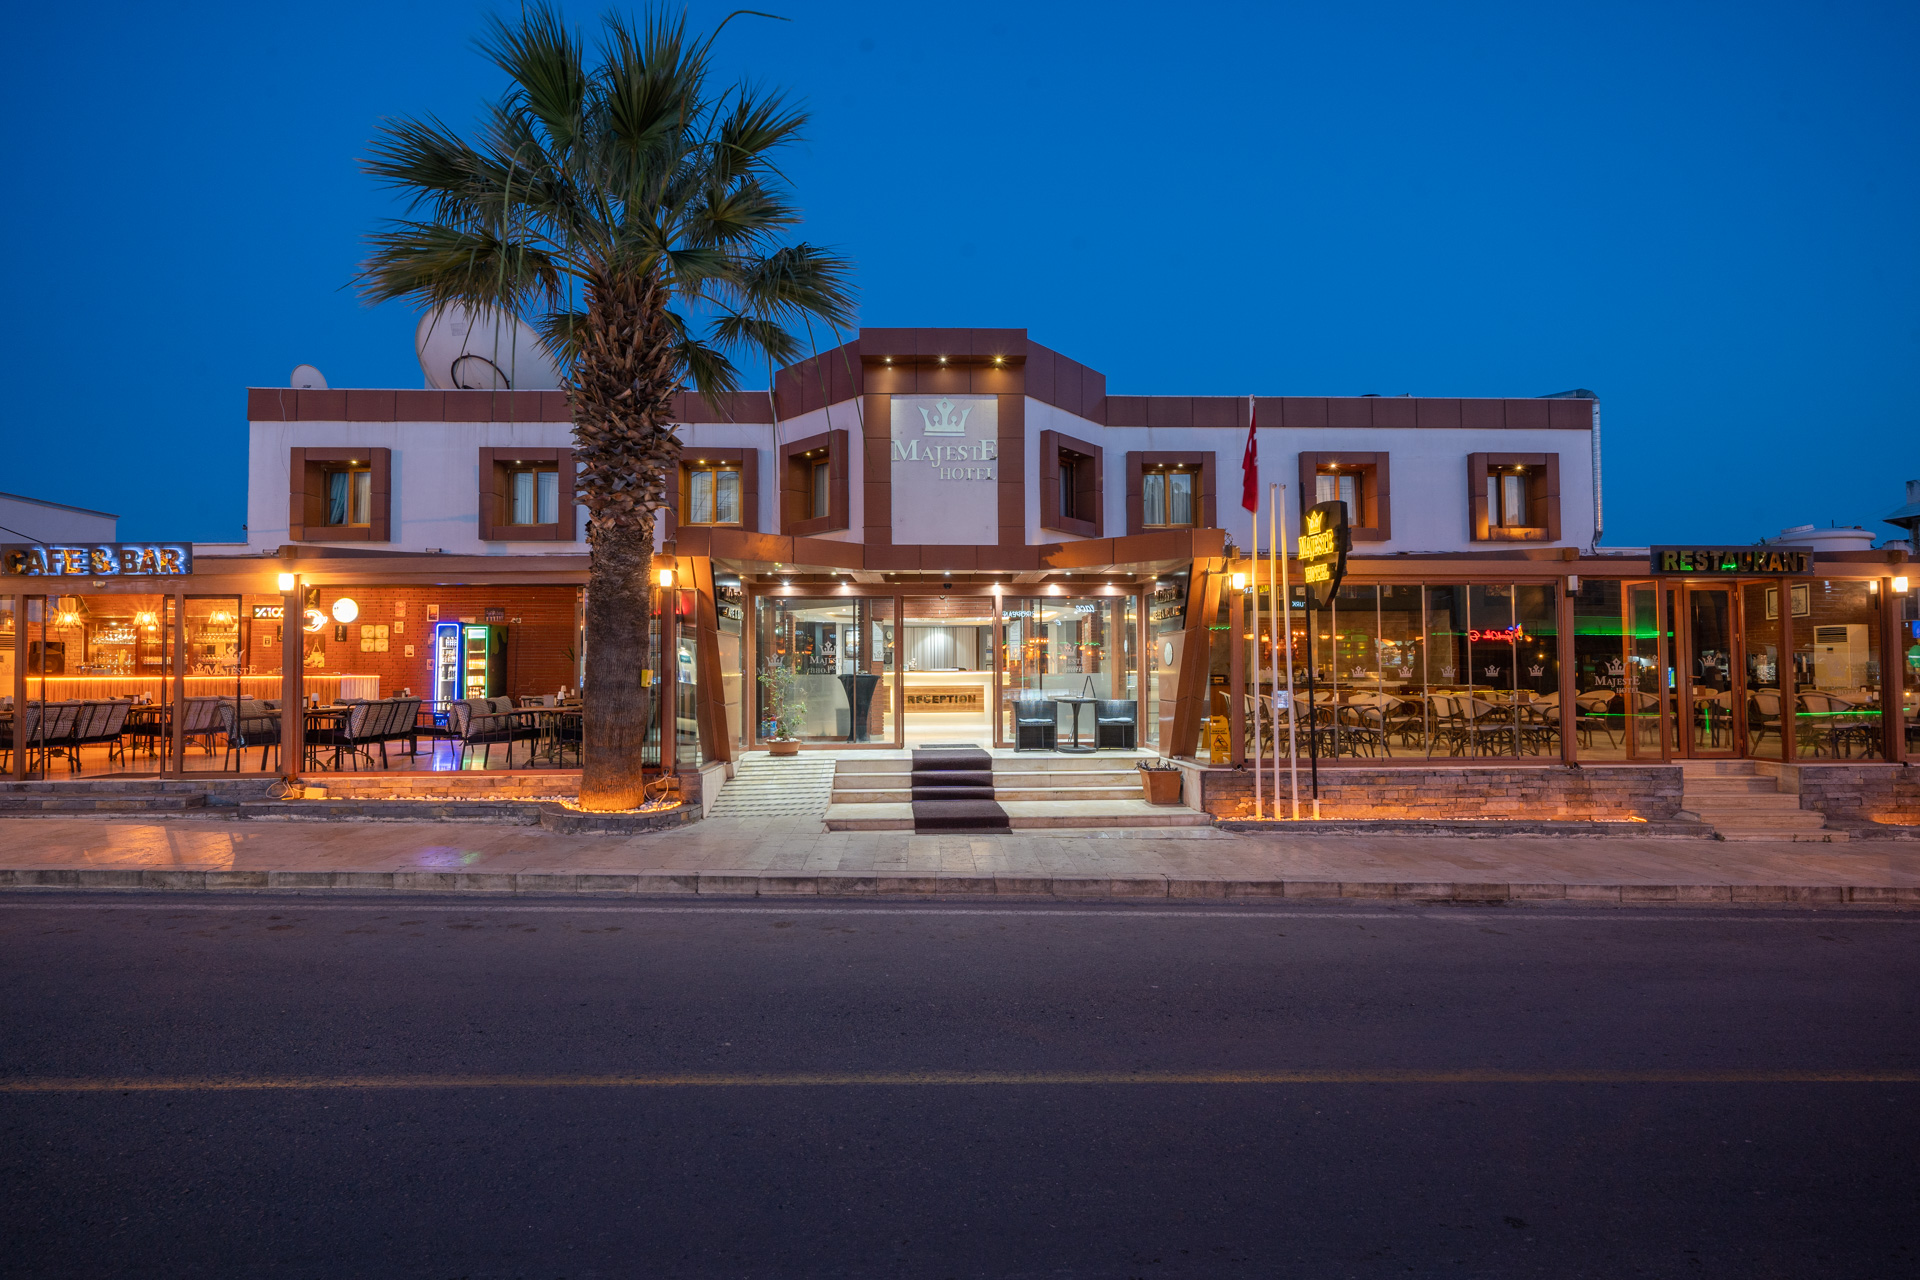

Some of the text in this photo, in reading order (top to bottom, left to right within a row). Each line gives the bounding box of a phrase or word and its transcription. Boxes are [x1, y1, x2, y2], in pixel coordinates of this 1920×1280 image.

[891, 439, 998, 468] MAJESTE
[940, 467, 997, 480] HOTEL
[1298, 529, 1335, 561] MAJESTE
[4, 548, 181, 574] CAFE & BAR
[1662, 551, 1812, 572] RESTAURANT
[1305, 563, 1330, 583] HOTEL
[1594, 675, 1640, 688] MAJESTE
[907, 694, 977, 704] RECEPTION
